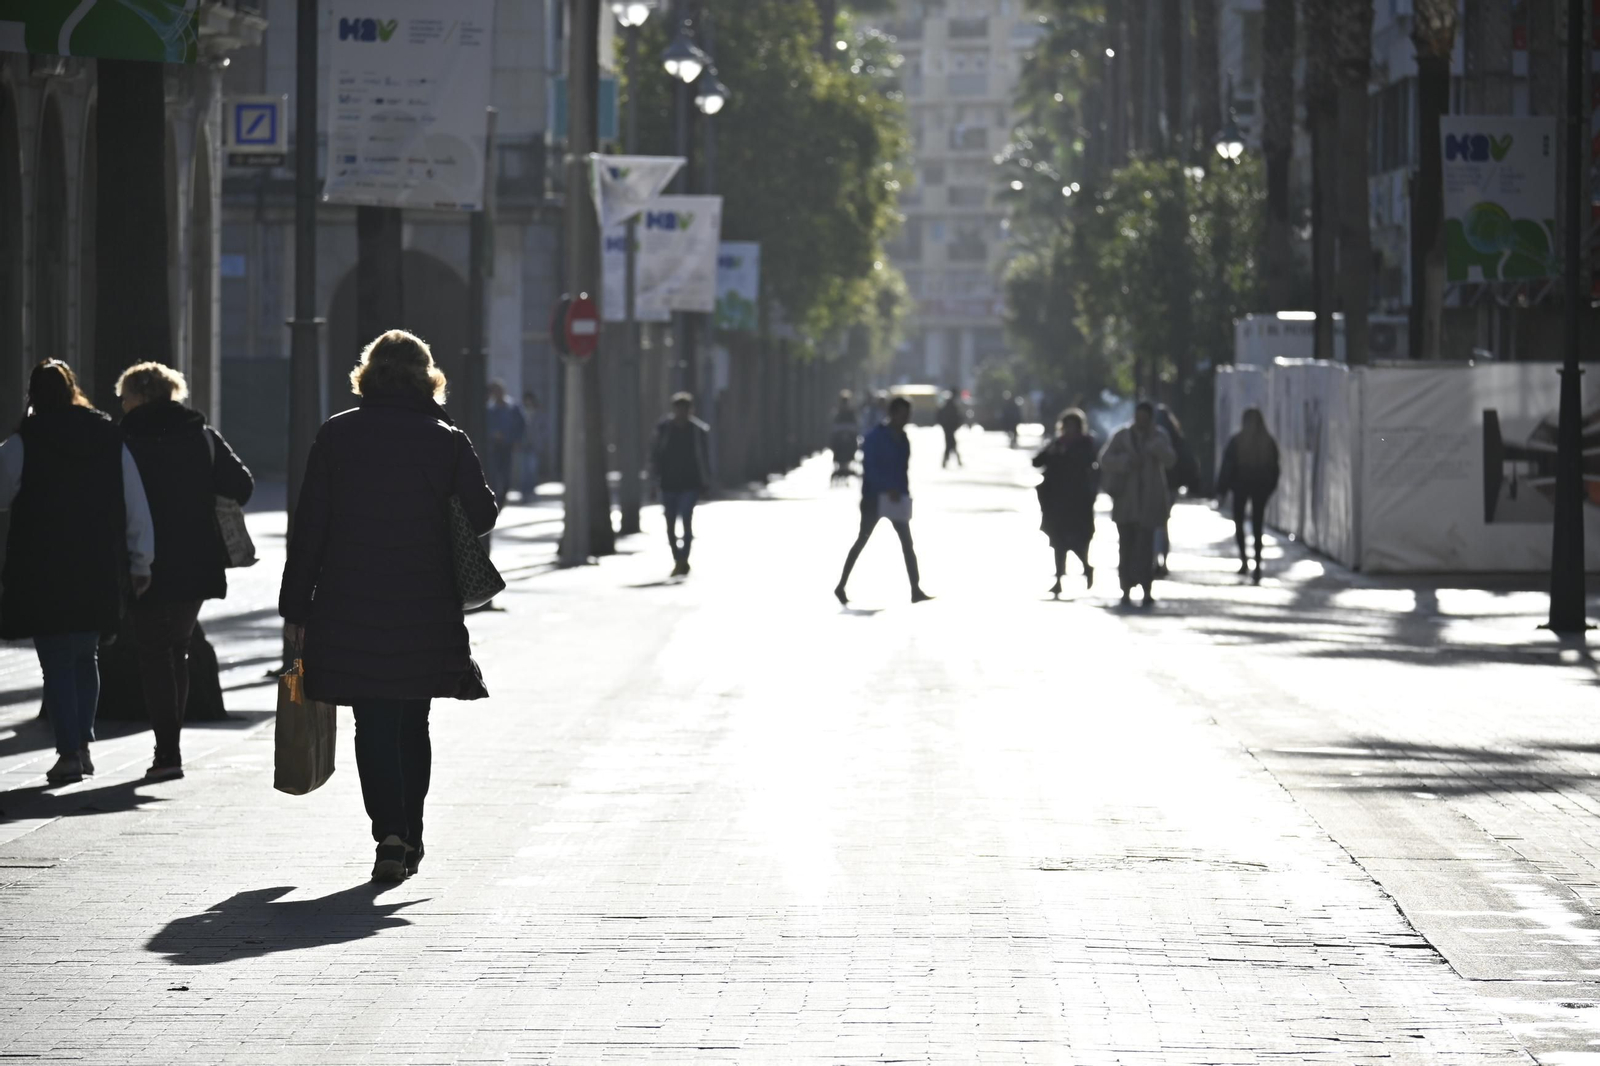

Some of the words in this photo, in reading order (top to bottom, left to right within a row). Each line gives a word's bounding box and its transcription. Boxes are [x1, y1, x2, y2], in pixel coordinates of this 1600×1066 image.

[339, 17, 399, 43] H2V
[1445, 132, 1514, 163] H2V
[646, 211, 695, 231] H2V
